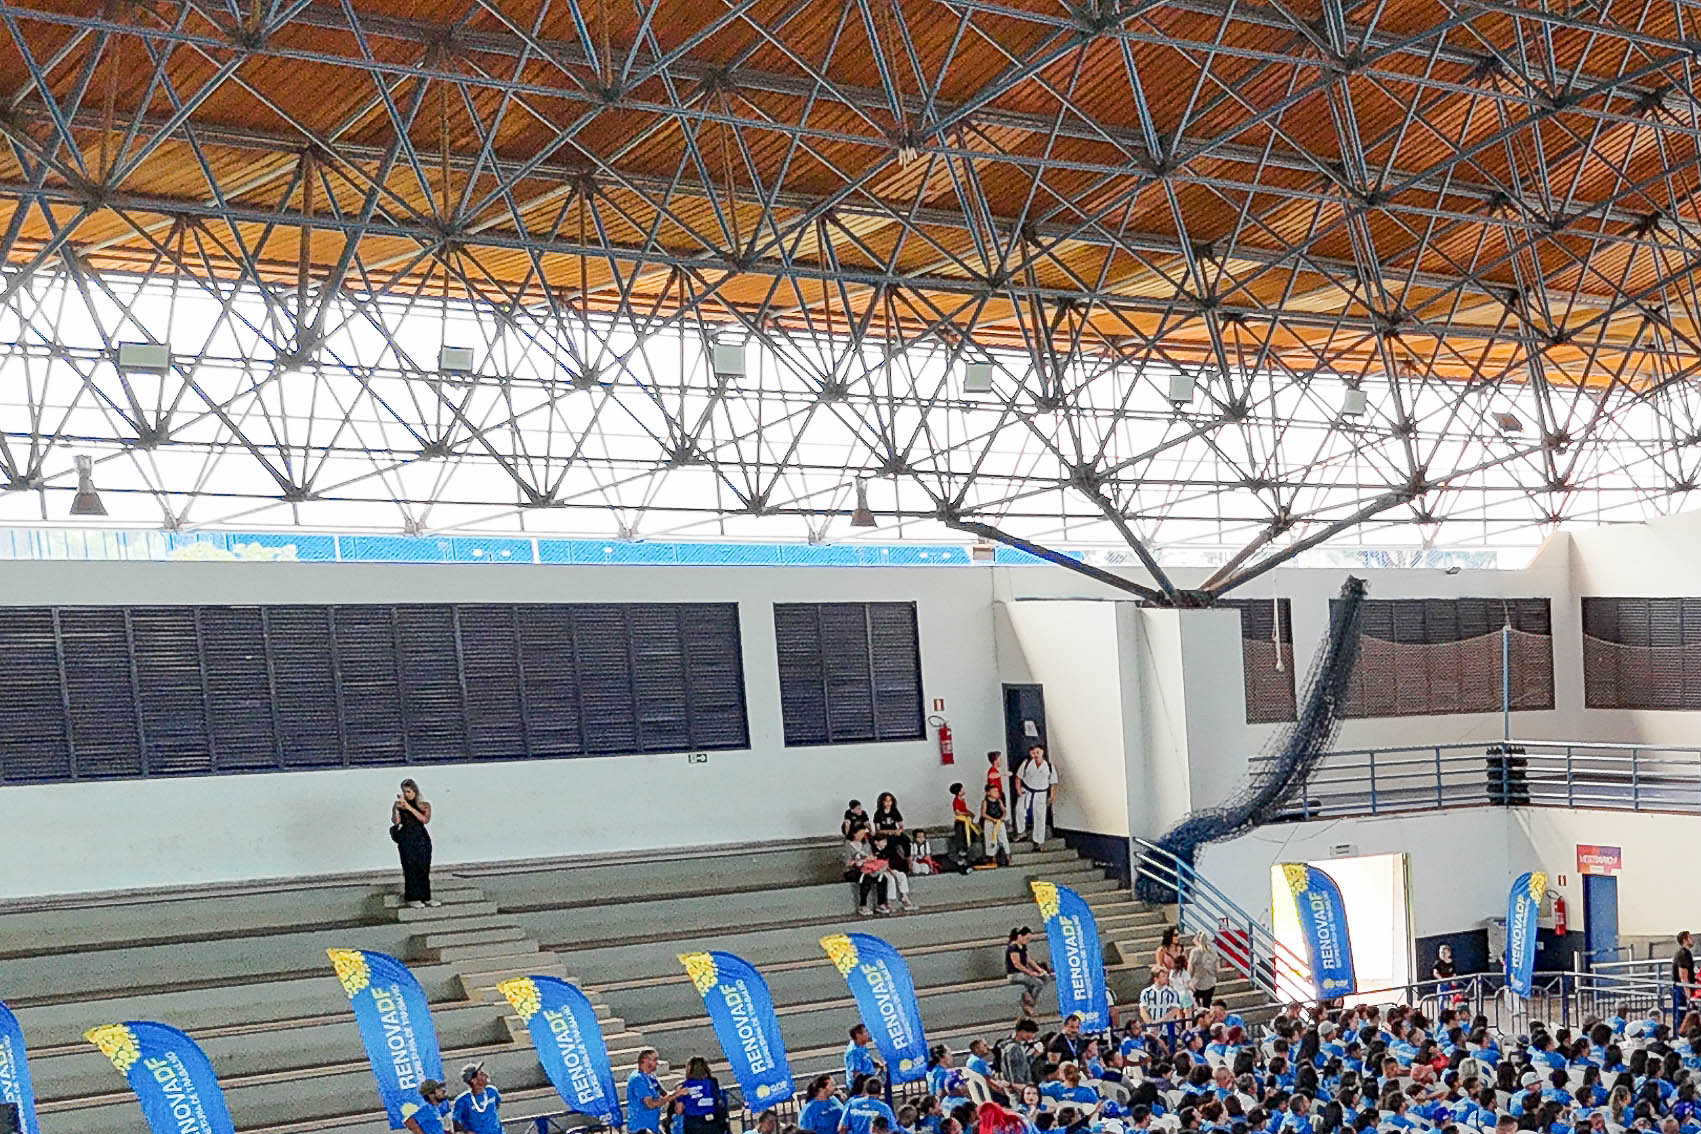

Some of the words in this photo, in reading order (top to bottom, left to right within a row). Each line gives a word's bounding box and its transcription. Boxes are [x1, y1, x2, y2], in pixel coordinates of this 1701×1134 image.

[1059, 915, 1087, 1001] RENOVADF
[371, 986, 417, 1090] RENOVADF
[720, 984, 767, 1074] RENOVADF
[861, 963, 909, 1050] RENOVADF
[543, 1009, 595, 1105] RENOVADF
